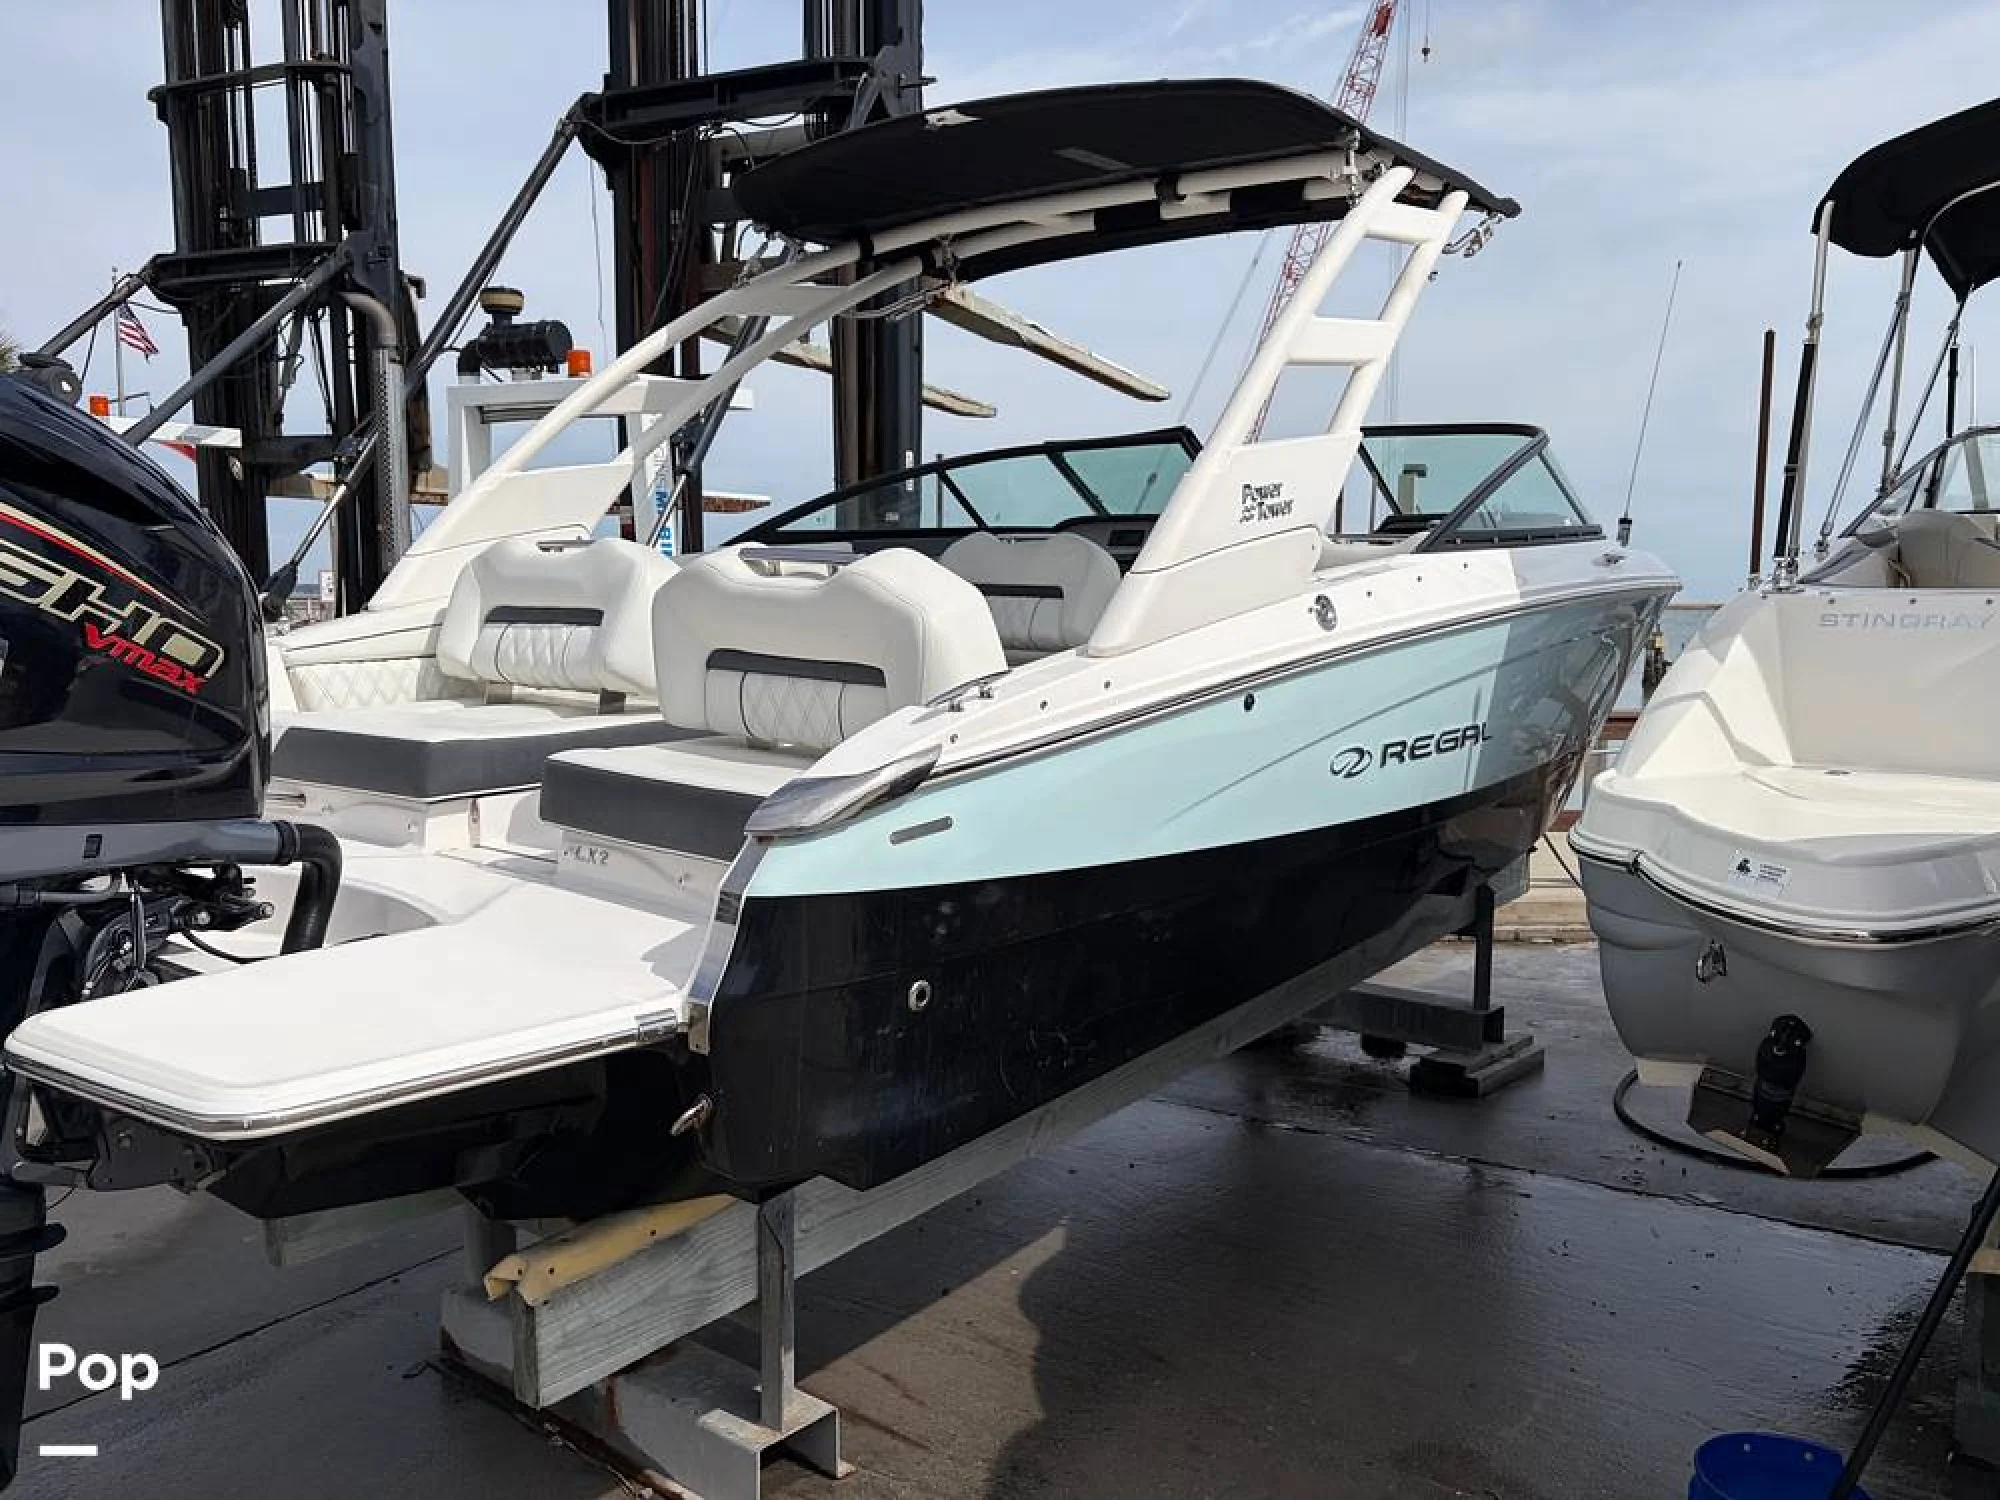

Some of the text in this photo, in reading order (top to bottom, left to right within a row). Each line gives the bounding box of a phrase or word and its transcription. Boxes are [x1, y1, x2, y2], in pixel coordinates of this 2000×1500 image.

[1242, 482, 1284, 504] Power
[1818, 612, 1996, 630] STINGRAY
[1379, 721, 1493, 769] REGAL
